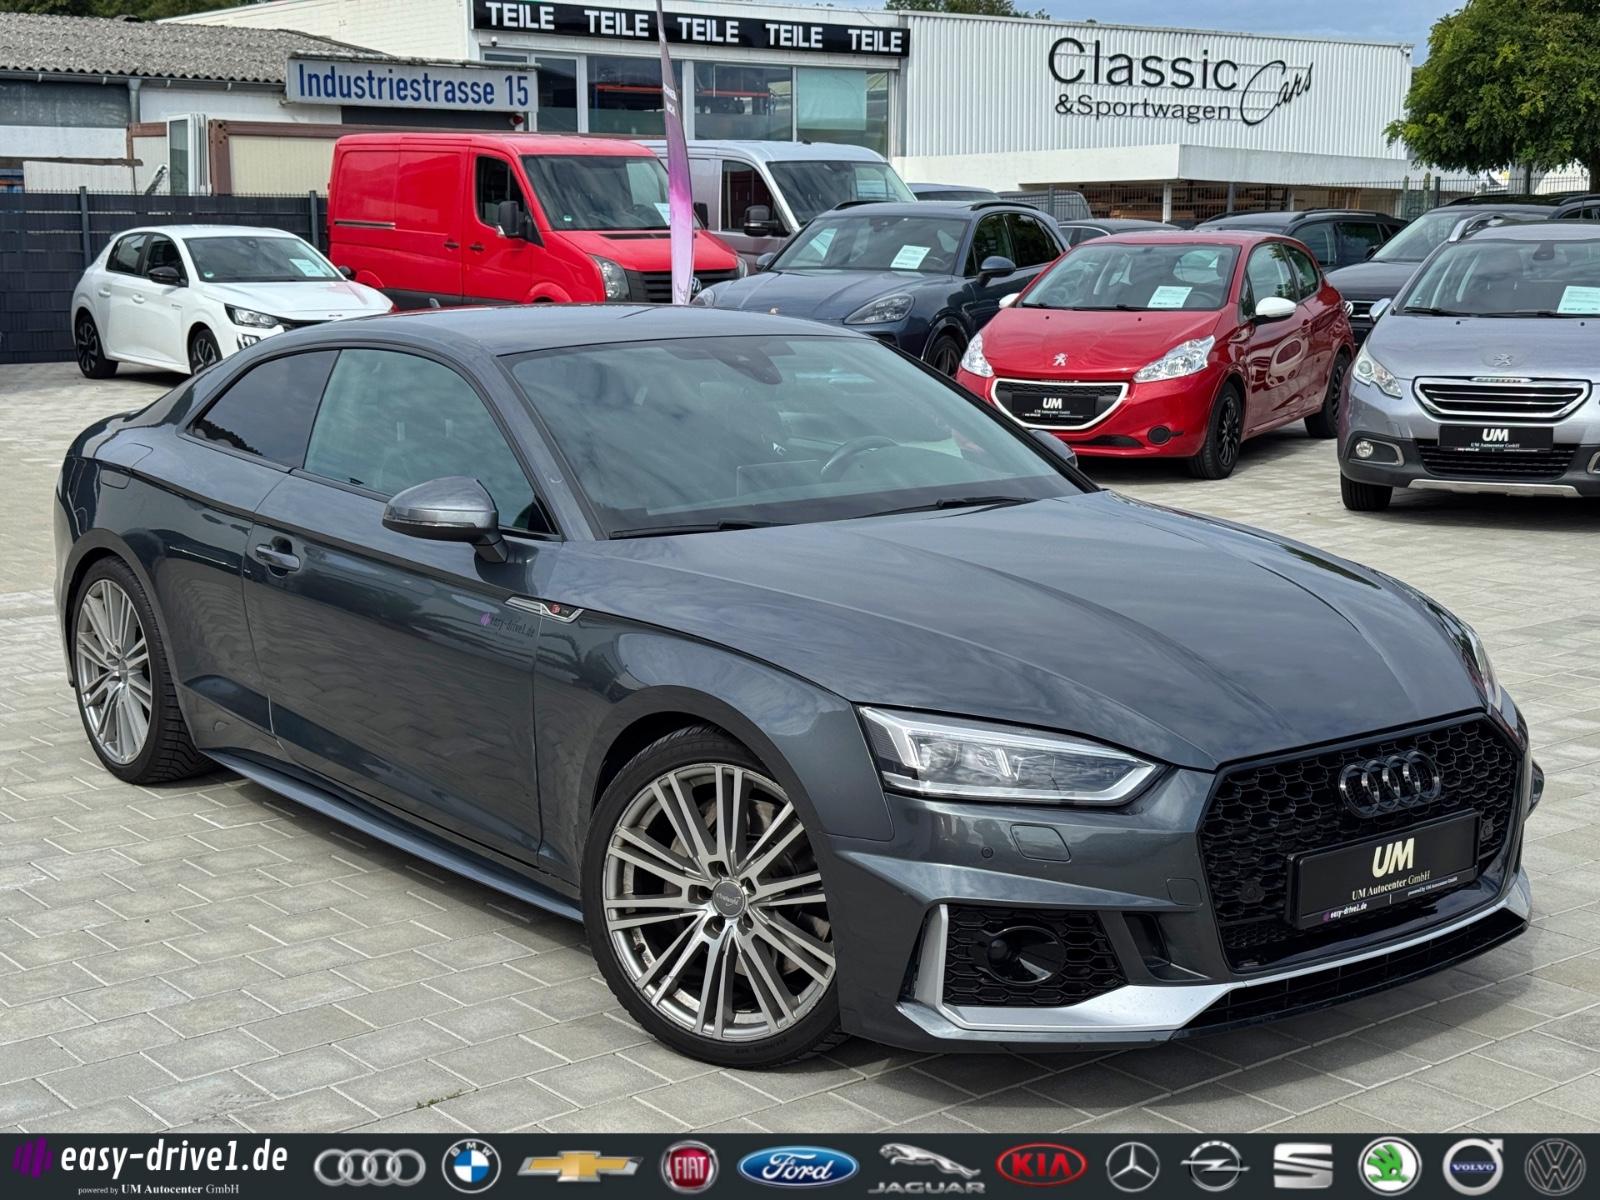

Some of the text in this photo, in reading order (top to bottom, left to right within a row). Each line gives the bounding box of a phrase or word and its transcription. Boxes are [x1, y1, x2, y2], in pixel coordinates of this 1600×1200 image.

[485, 1, 902, 53] TEILE TEILE TEILE TEILE TEILE
[299, 63, 529, 106] Industriestrasse 15
[1048, 37, 1314, 126] Classic Cars
[1054, 93, 1232, 124] &Sportwagen
[1042, 397, 1063, 409] UM
[1482, 428, 1509, 442] UM
[1372, 837, 1415, 878] UM
[1352, 887, 1367, 901] UM
[1367, 879, 1407, 897] Autocenter
[1408, 870, 1431, 885] GmbH
